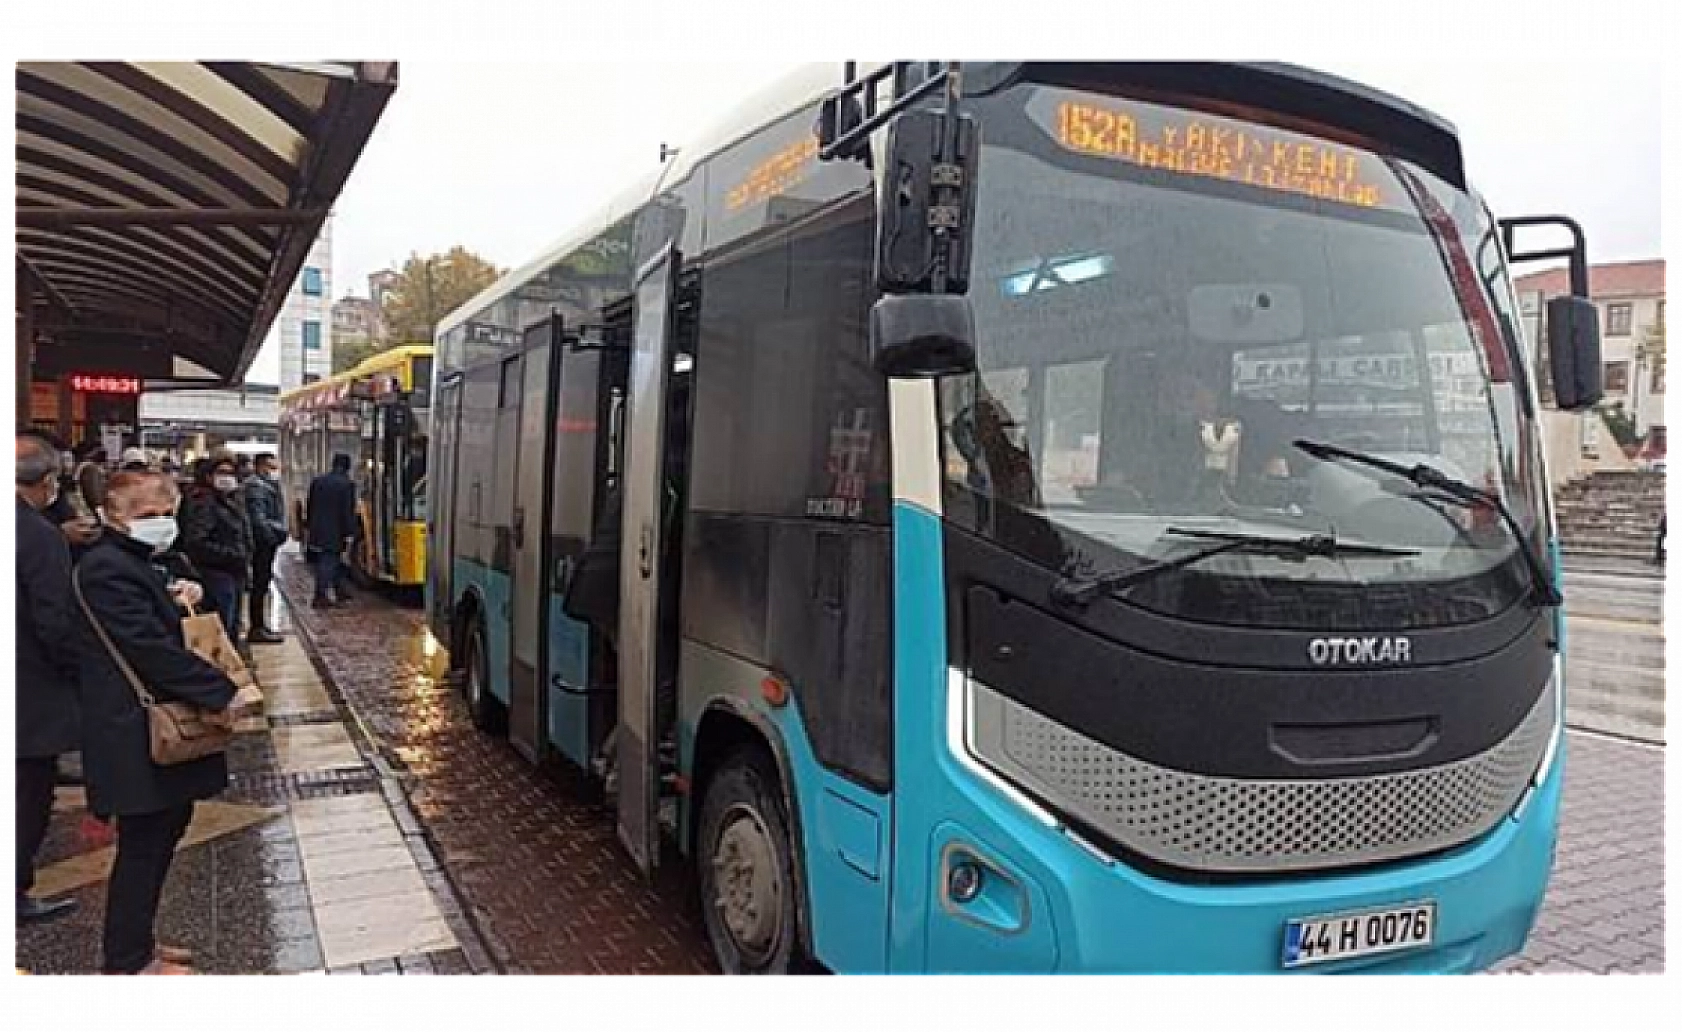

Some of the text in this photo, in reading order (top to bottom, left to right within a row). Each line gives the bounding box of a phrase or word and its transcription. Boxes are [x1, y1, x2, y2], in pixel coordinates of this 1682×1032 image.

[1309, 637, 1411, 664] OTOKAR
[1301, 910, 1427, 957] 44 H 0076
